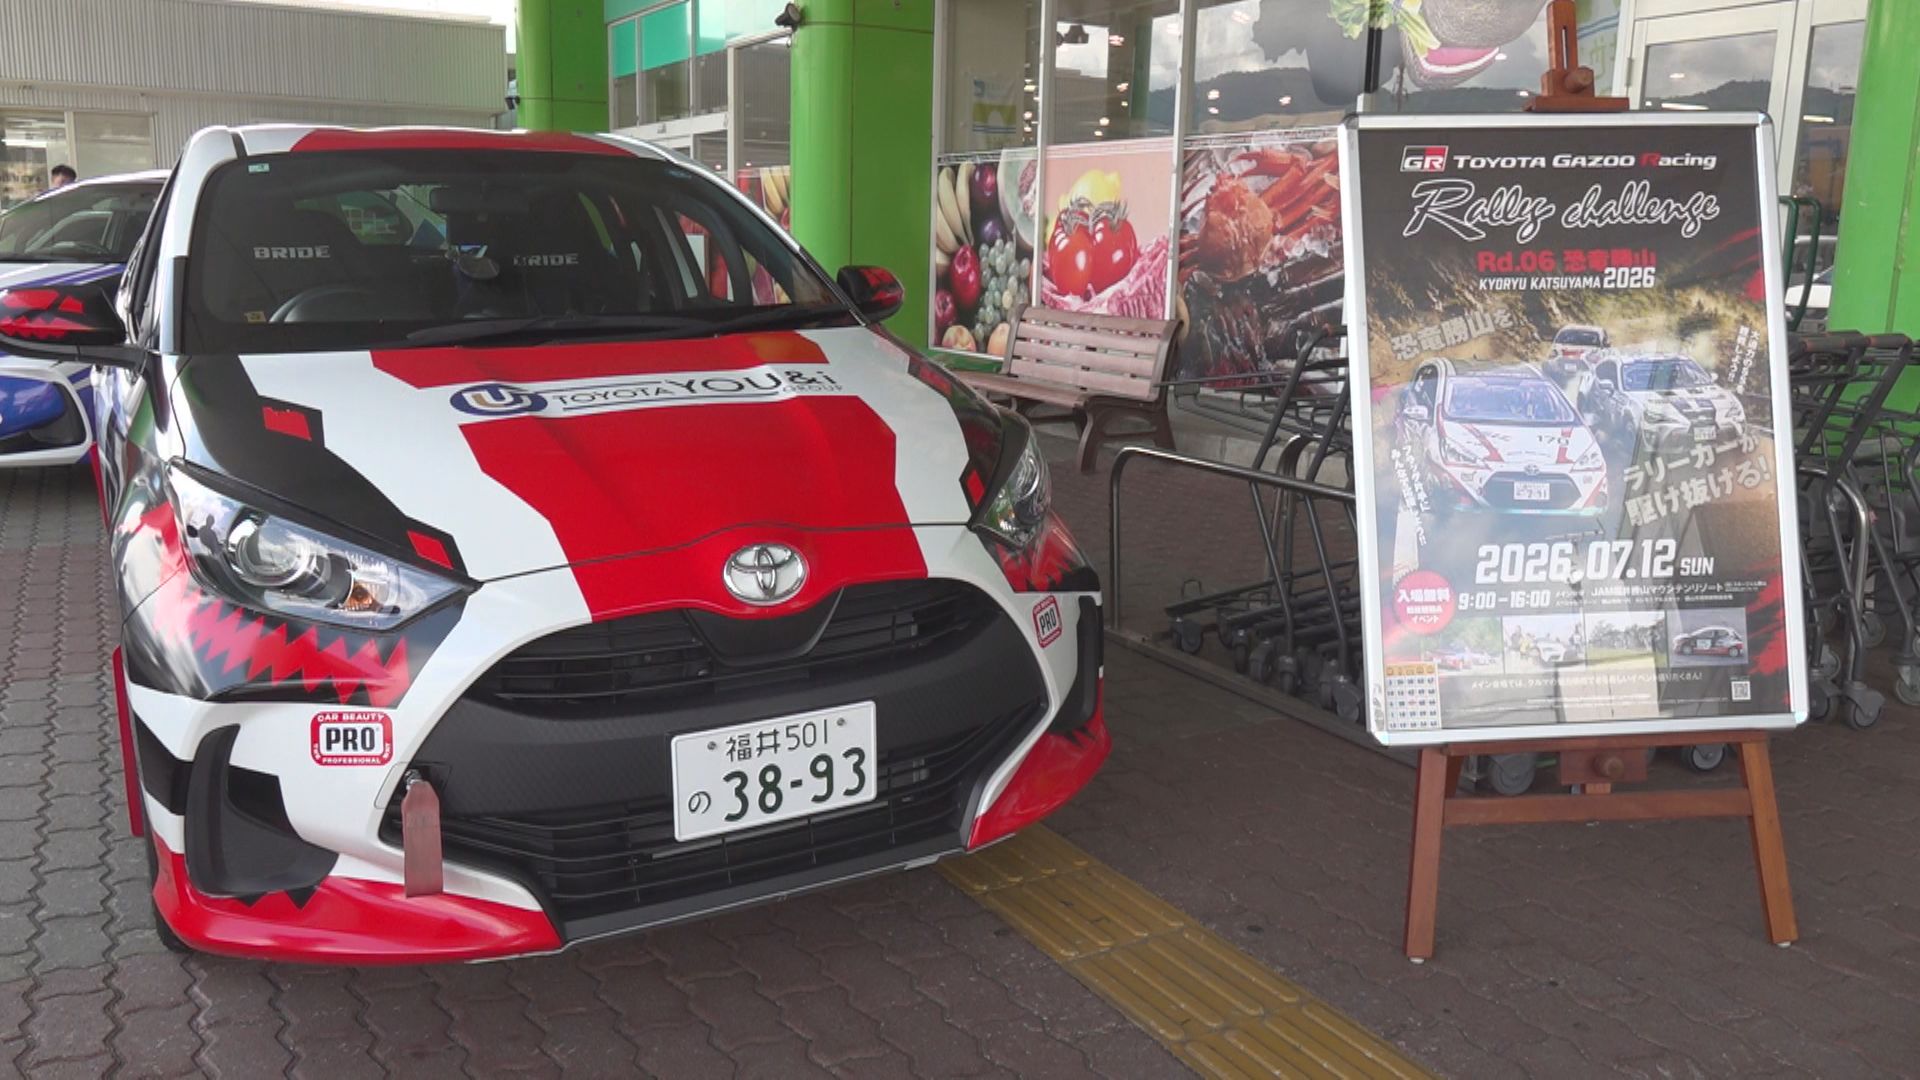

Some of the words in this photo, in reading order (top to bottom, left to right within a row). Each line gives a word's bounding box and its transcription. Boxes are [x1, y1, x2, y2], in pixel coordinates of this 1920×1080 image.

[1453, 155, 1546, 169] TOYOTA
[1552, 154, 1636, 168] GAZOO
[1641, 153, 1718, 170] Racing
[1402, 178, 1556, 244] Rally
[1562, 180, 1721, 238] challenge
[253, 245, 331, 260] BRIDE
[1476, 250, 1556, 273] Rd.06
[1479, 278, 1527, 291] KYORYU
[1530, 276, 1602, 290] KATSUYAMA
[1603, 267, 1657, 289] 2026
[552, 385, 675, 407] TOYOTA
[1623, 431, 1760, 491] ラリーカーが
[1475, 539, 1677, 585] 2026.07.12
[1679, 557, 1715, 577] SUN
[1038, 607, 1057, 635] PRO
[1411, 615, 1439, 624] イベント
[317, 713, 338, 722] CAR
[342, 712, 384, 722] BEAUTY
[326, 727, 375, 752] PRO
[725, 728, 781, 763] 福井
[786, 719, 828, 752] 501
[688, 791, 712, 815] の
[722, 747, 866, 822] 38-93
